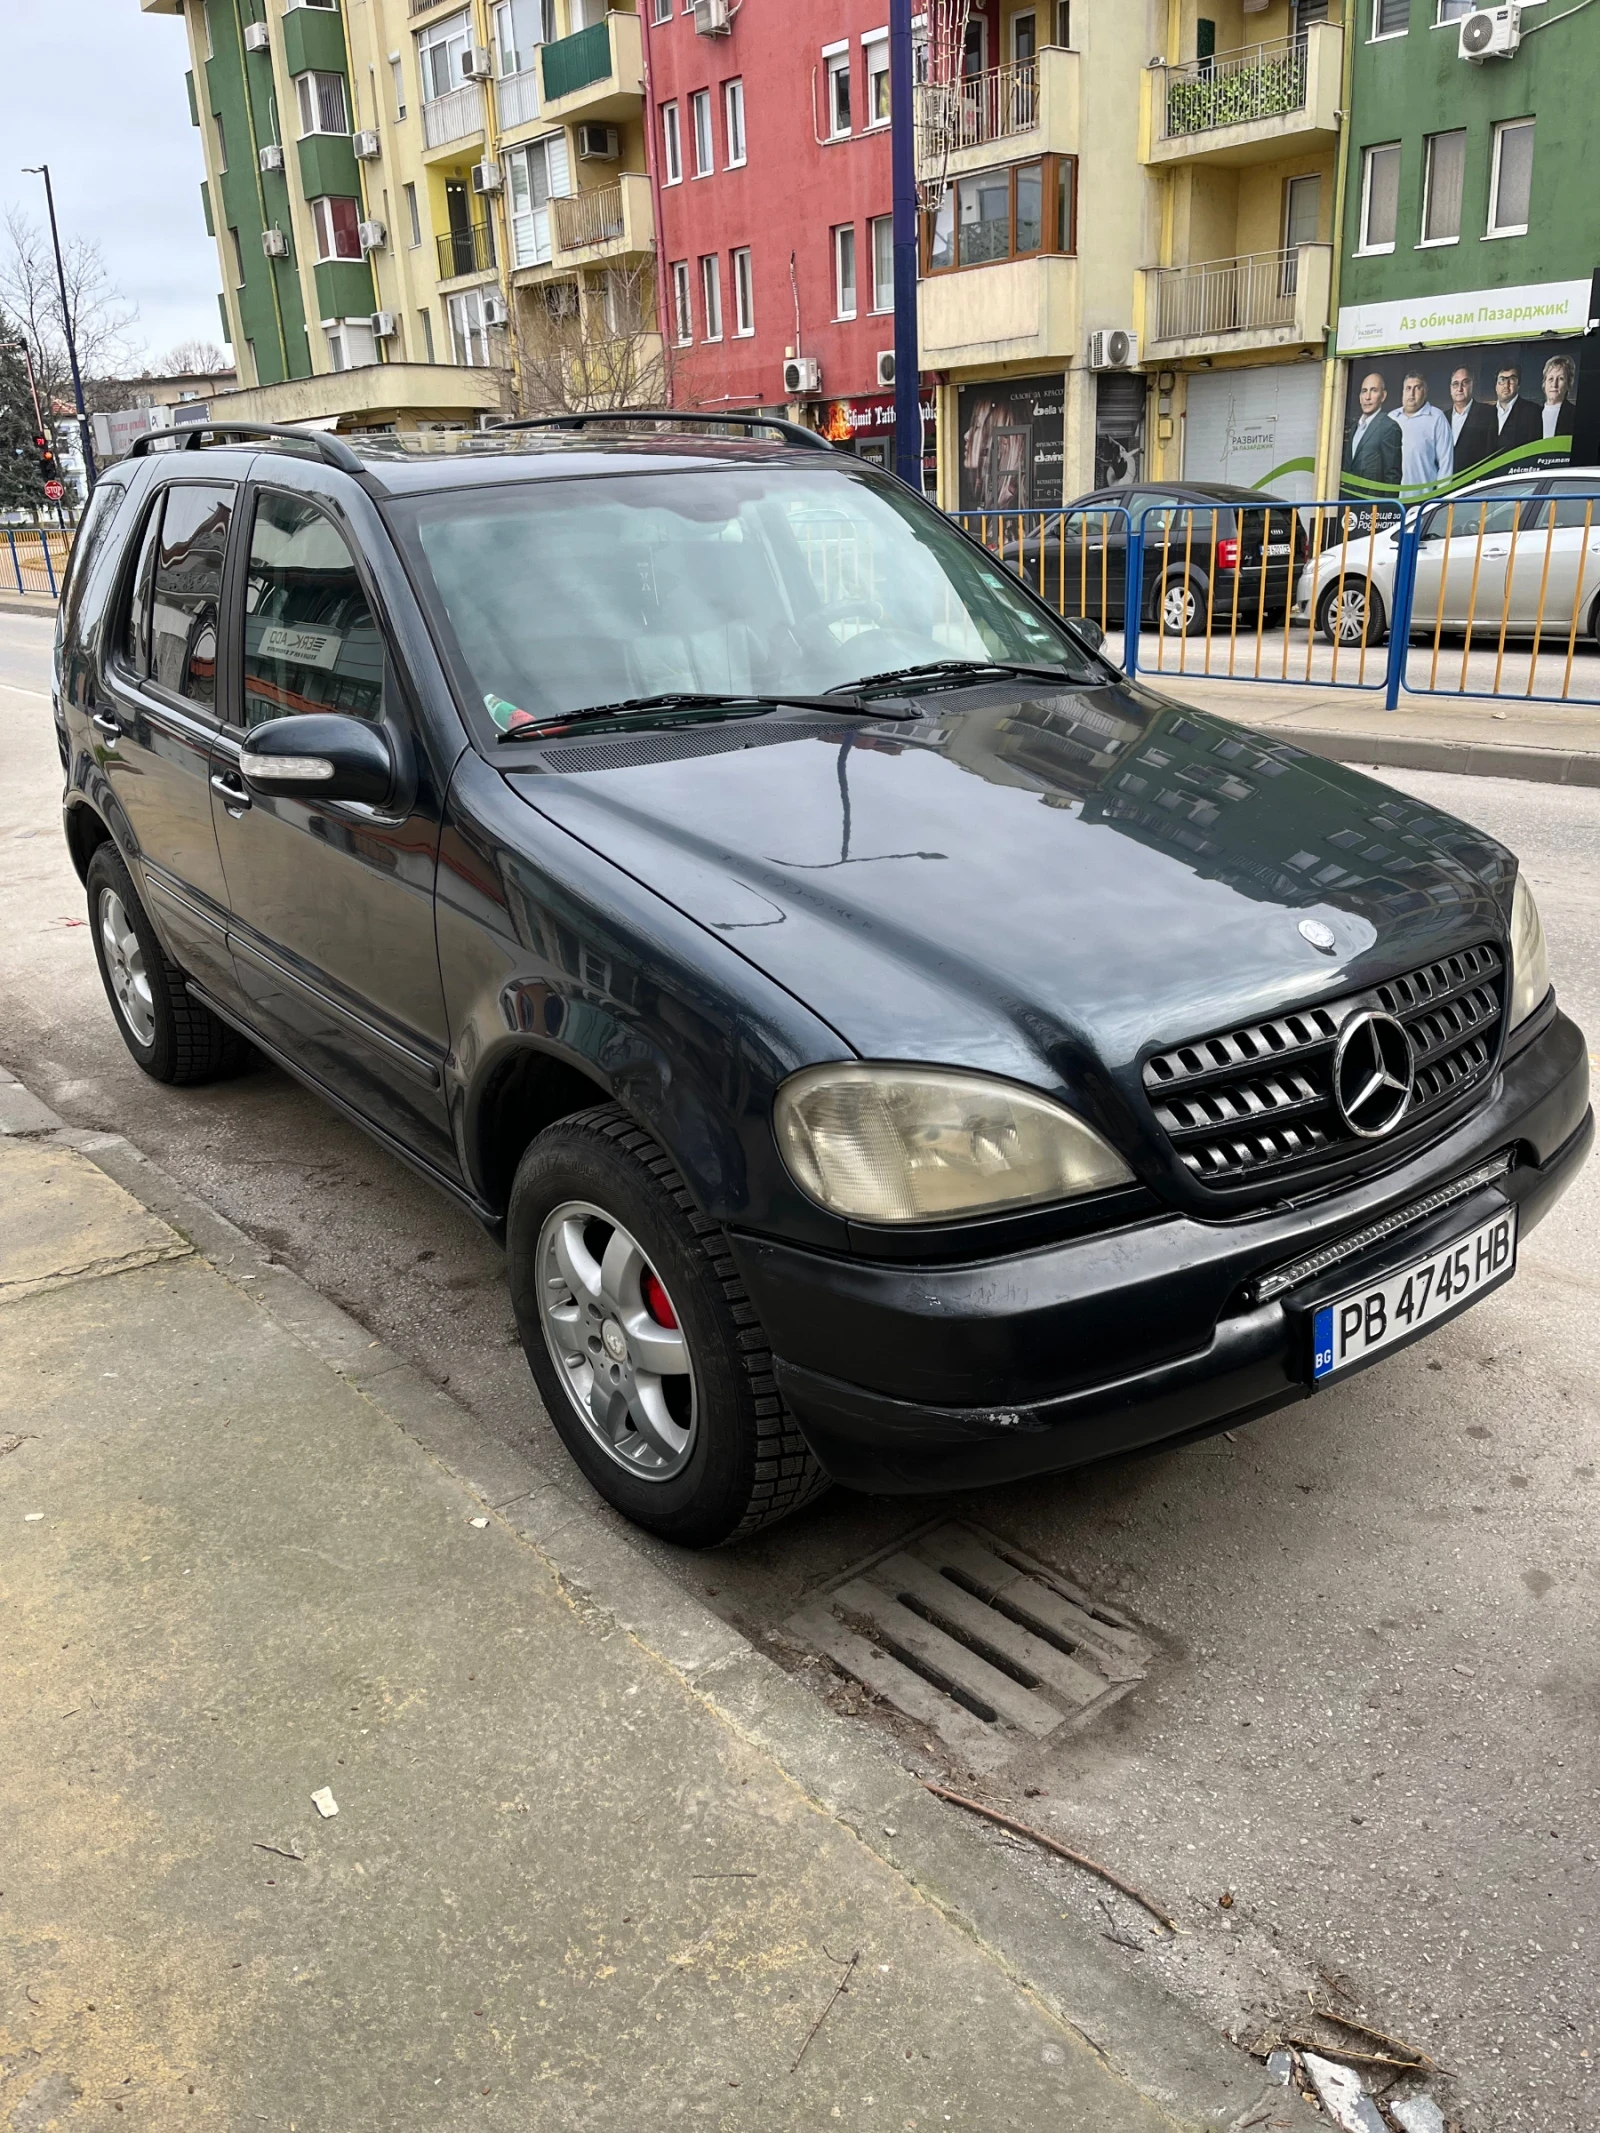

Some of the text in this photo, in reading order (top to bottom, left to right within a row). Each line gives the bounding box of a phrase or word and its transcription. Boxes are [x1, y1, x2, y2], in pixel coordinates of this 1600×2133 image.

[1399, 300, 1569, 330] Аз обичам Пазарджик!
[1044, 389, 1065, 398] КРАСО
[1033, 402, 1057, 416] bella
[1232, 434, 1274, 445] РАЗВИТИЕ
[1034, 449, 1064, 463] davine
[1339, 1219, 1510, 1360] PB 4745 HB
[1315, 1349, 1332, 1369] BG
